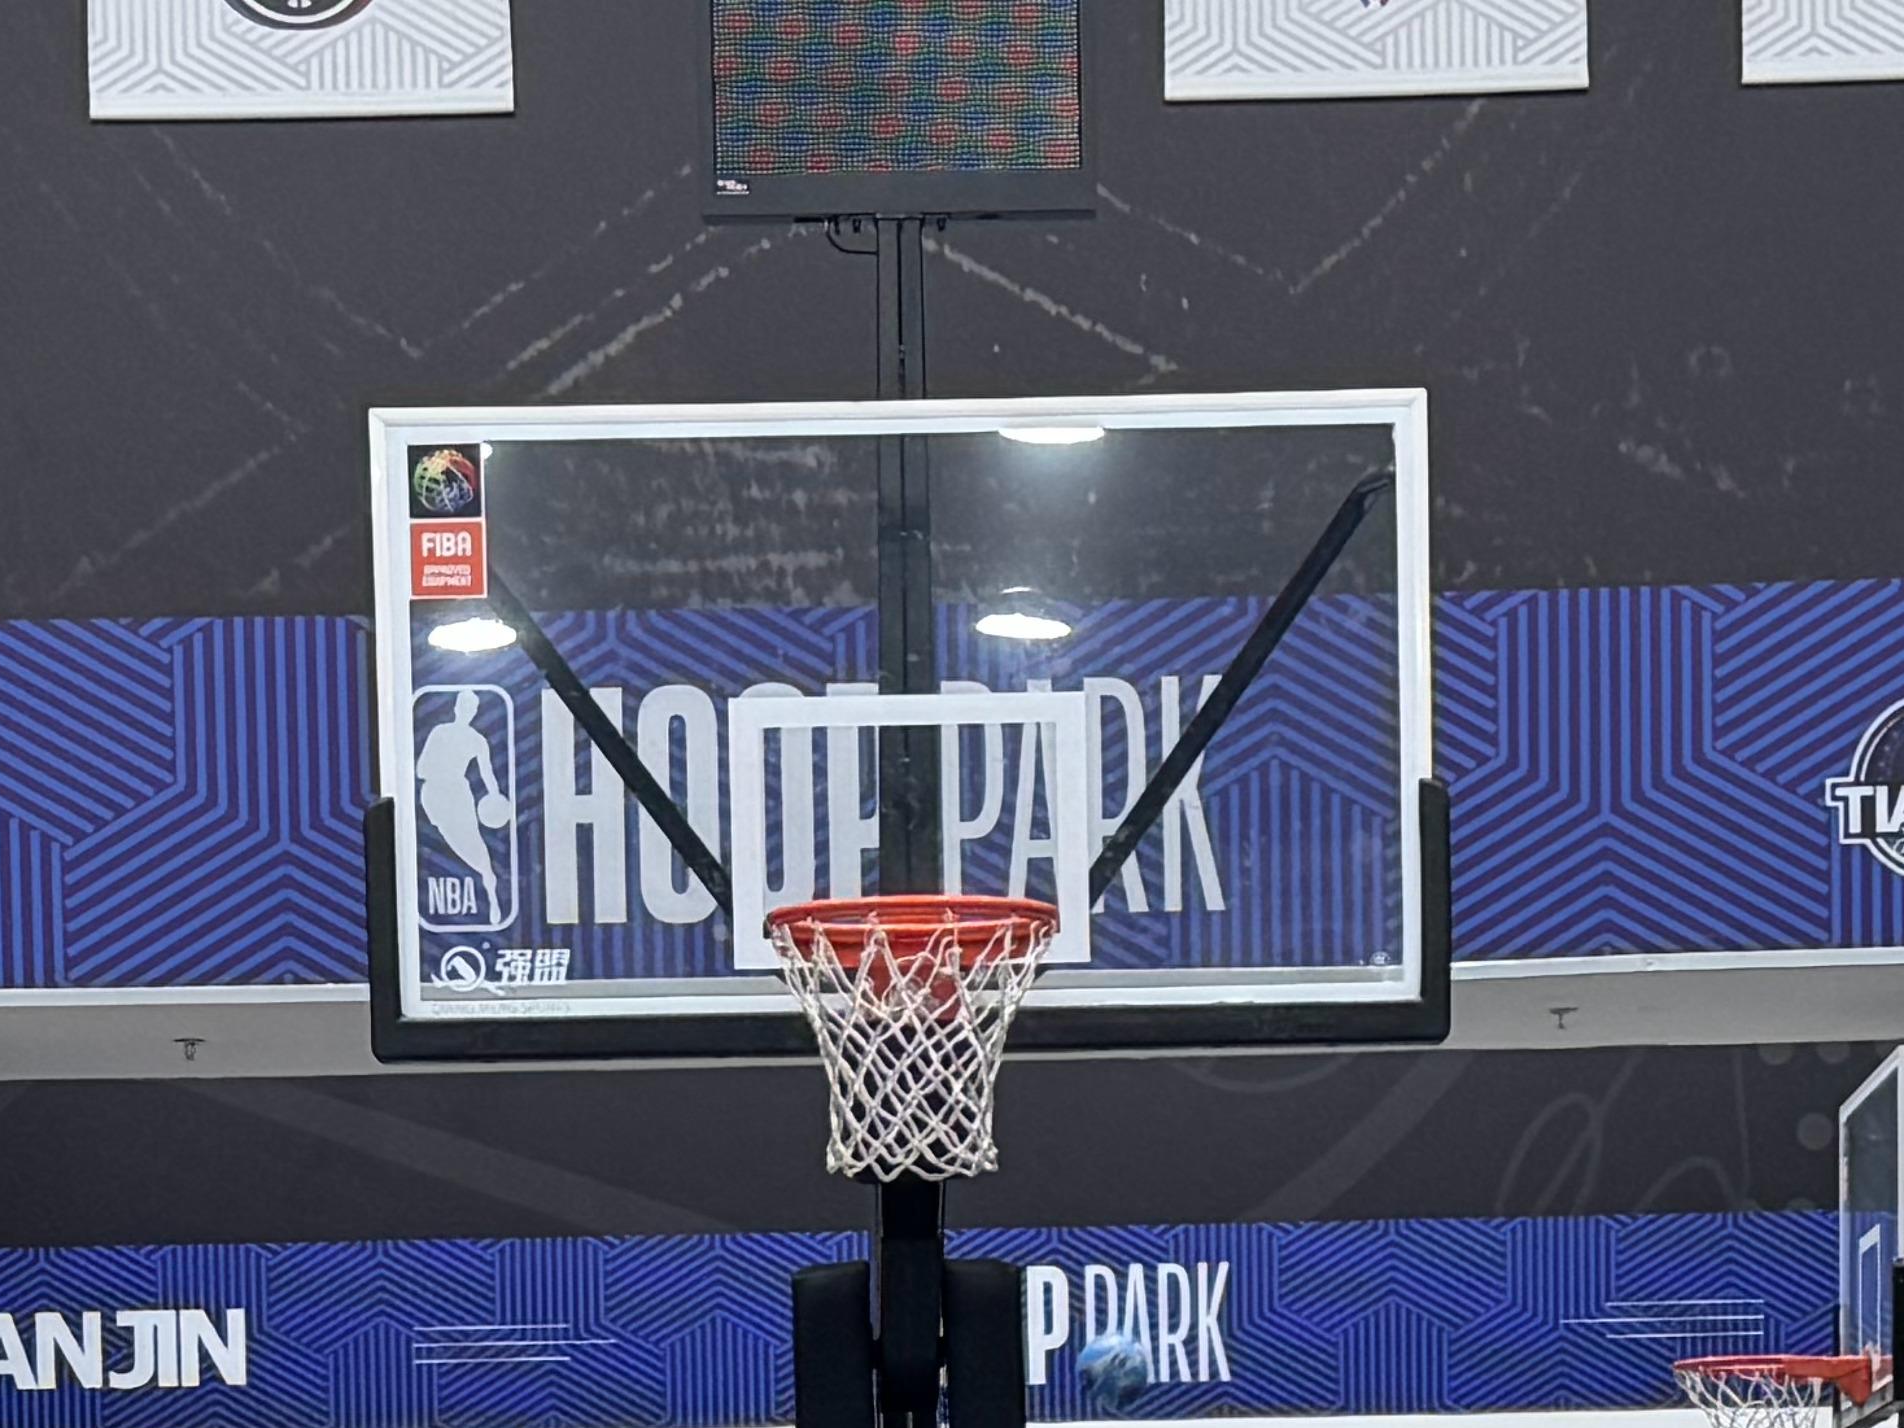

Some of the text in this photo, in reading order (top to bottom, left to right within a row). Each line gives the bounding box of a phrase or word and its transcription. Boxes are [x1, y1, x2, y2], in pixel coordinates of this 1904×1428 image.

[422, 531, 472, 557] FIBA
[940, 675, 1226, 913] PARK
[428, 877, 478, 915] NBA
[496, 948, 571, 986] 强盟
[1084, 1261, 1232, 1384] PARK
